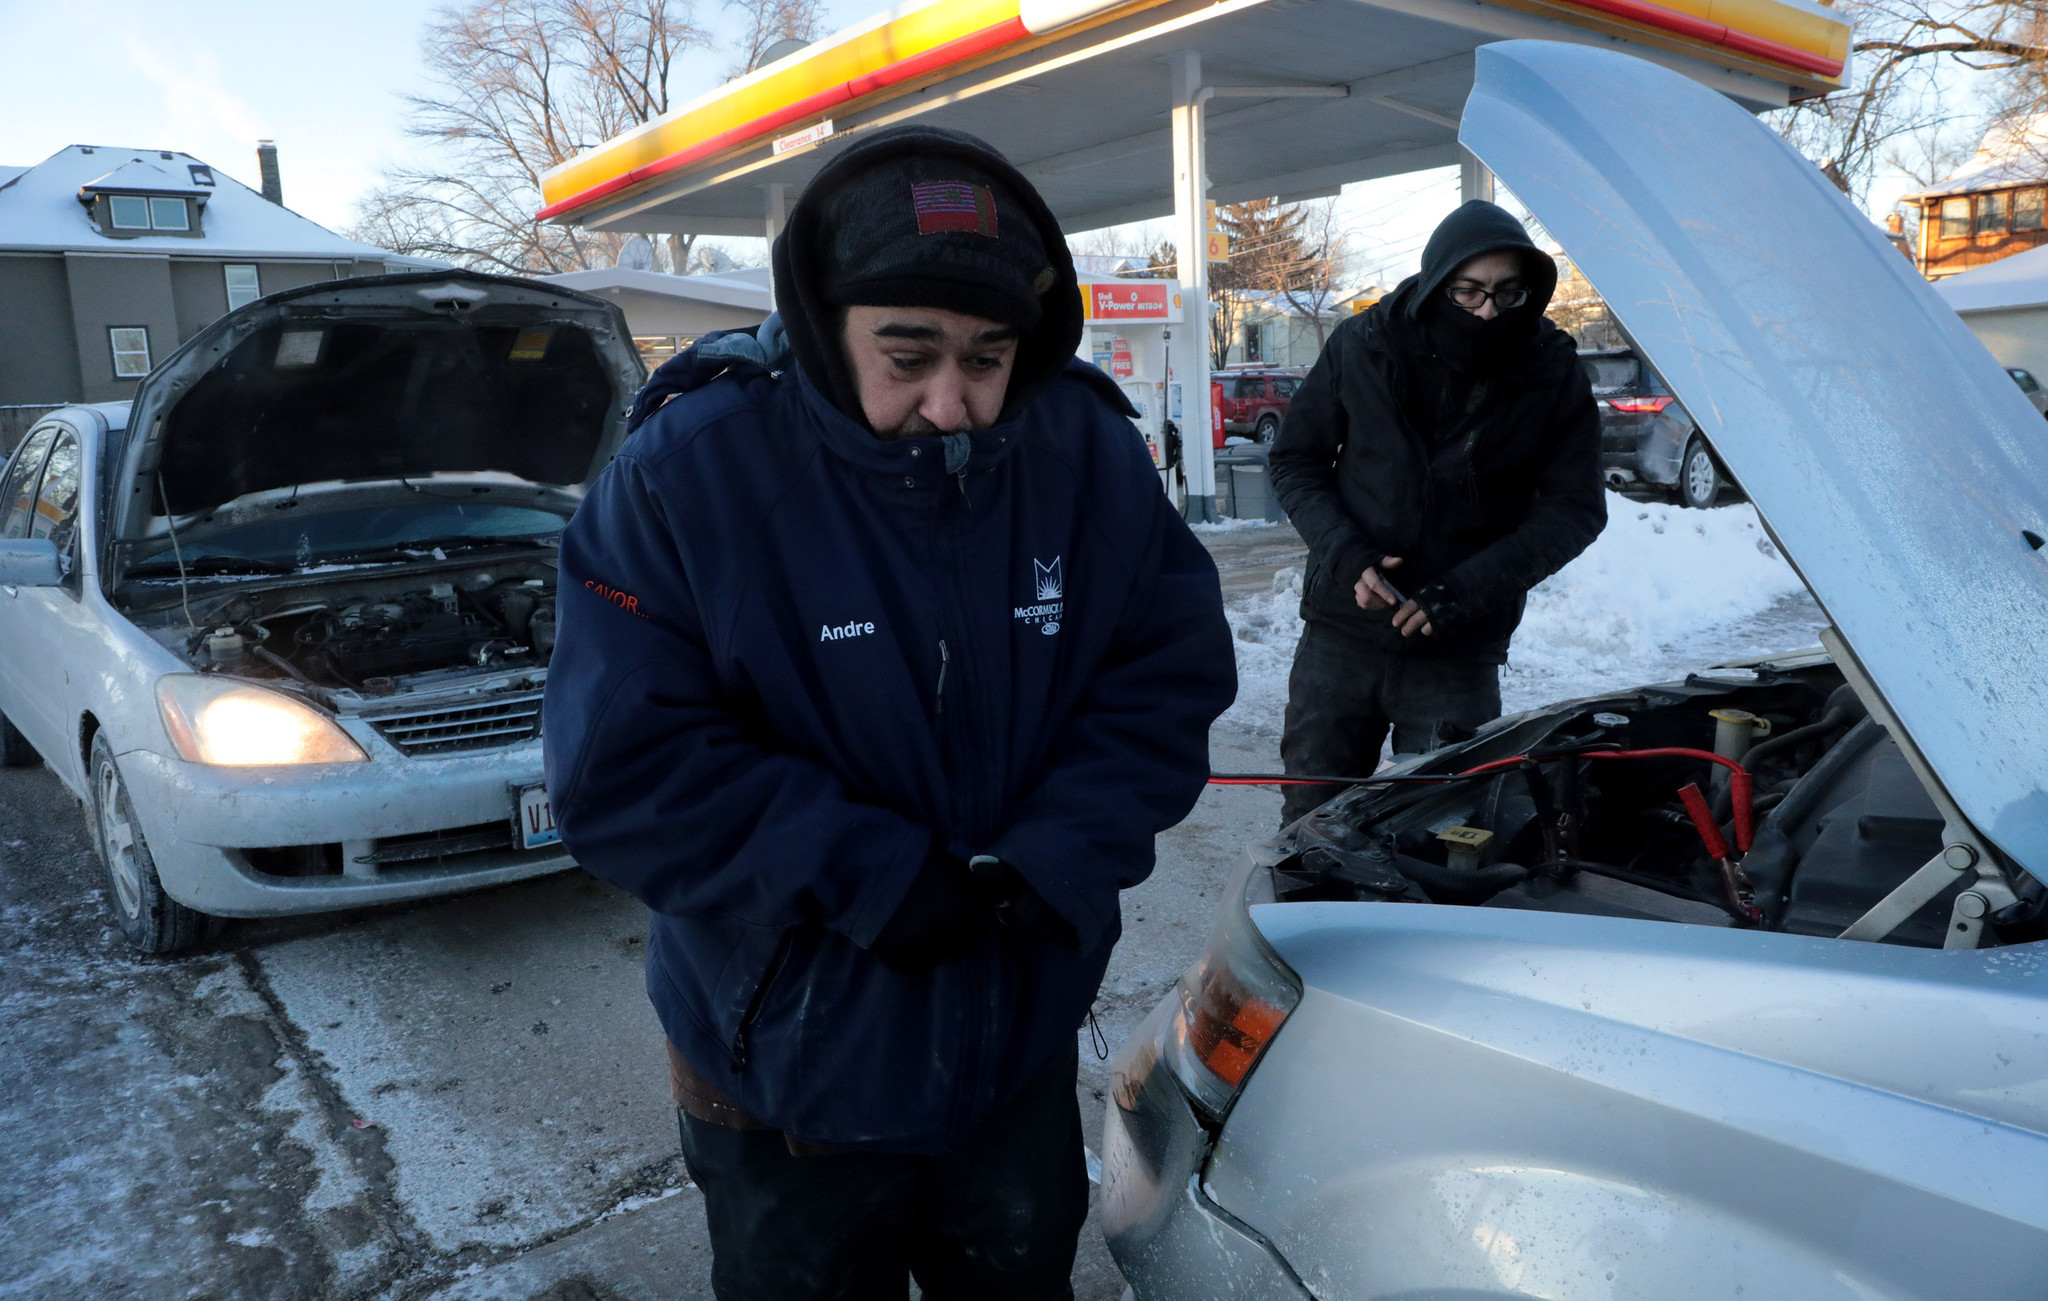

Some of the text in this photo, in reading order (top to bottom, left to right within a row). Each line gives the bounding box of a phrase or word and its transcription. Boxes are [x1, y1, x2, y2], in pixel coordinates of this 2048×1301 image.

[780, 133, 812, 151] Clearance
[1208, 237, 1219, 256] 6
[1098, 292, 1113, 300] Shell
[1098, 300, 1135, 311] V-Power
[1112, 361, 1131, 370] FREE
[820, 620, 875, 642] Andre
[528, 802, 555, 834] V1
